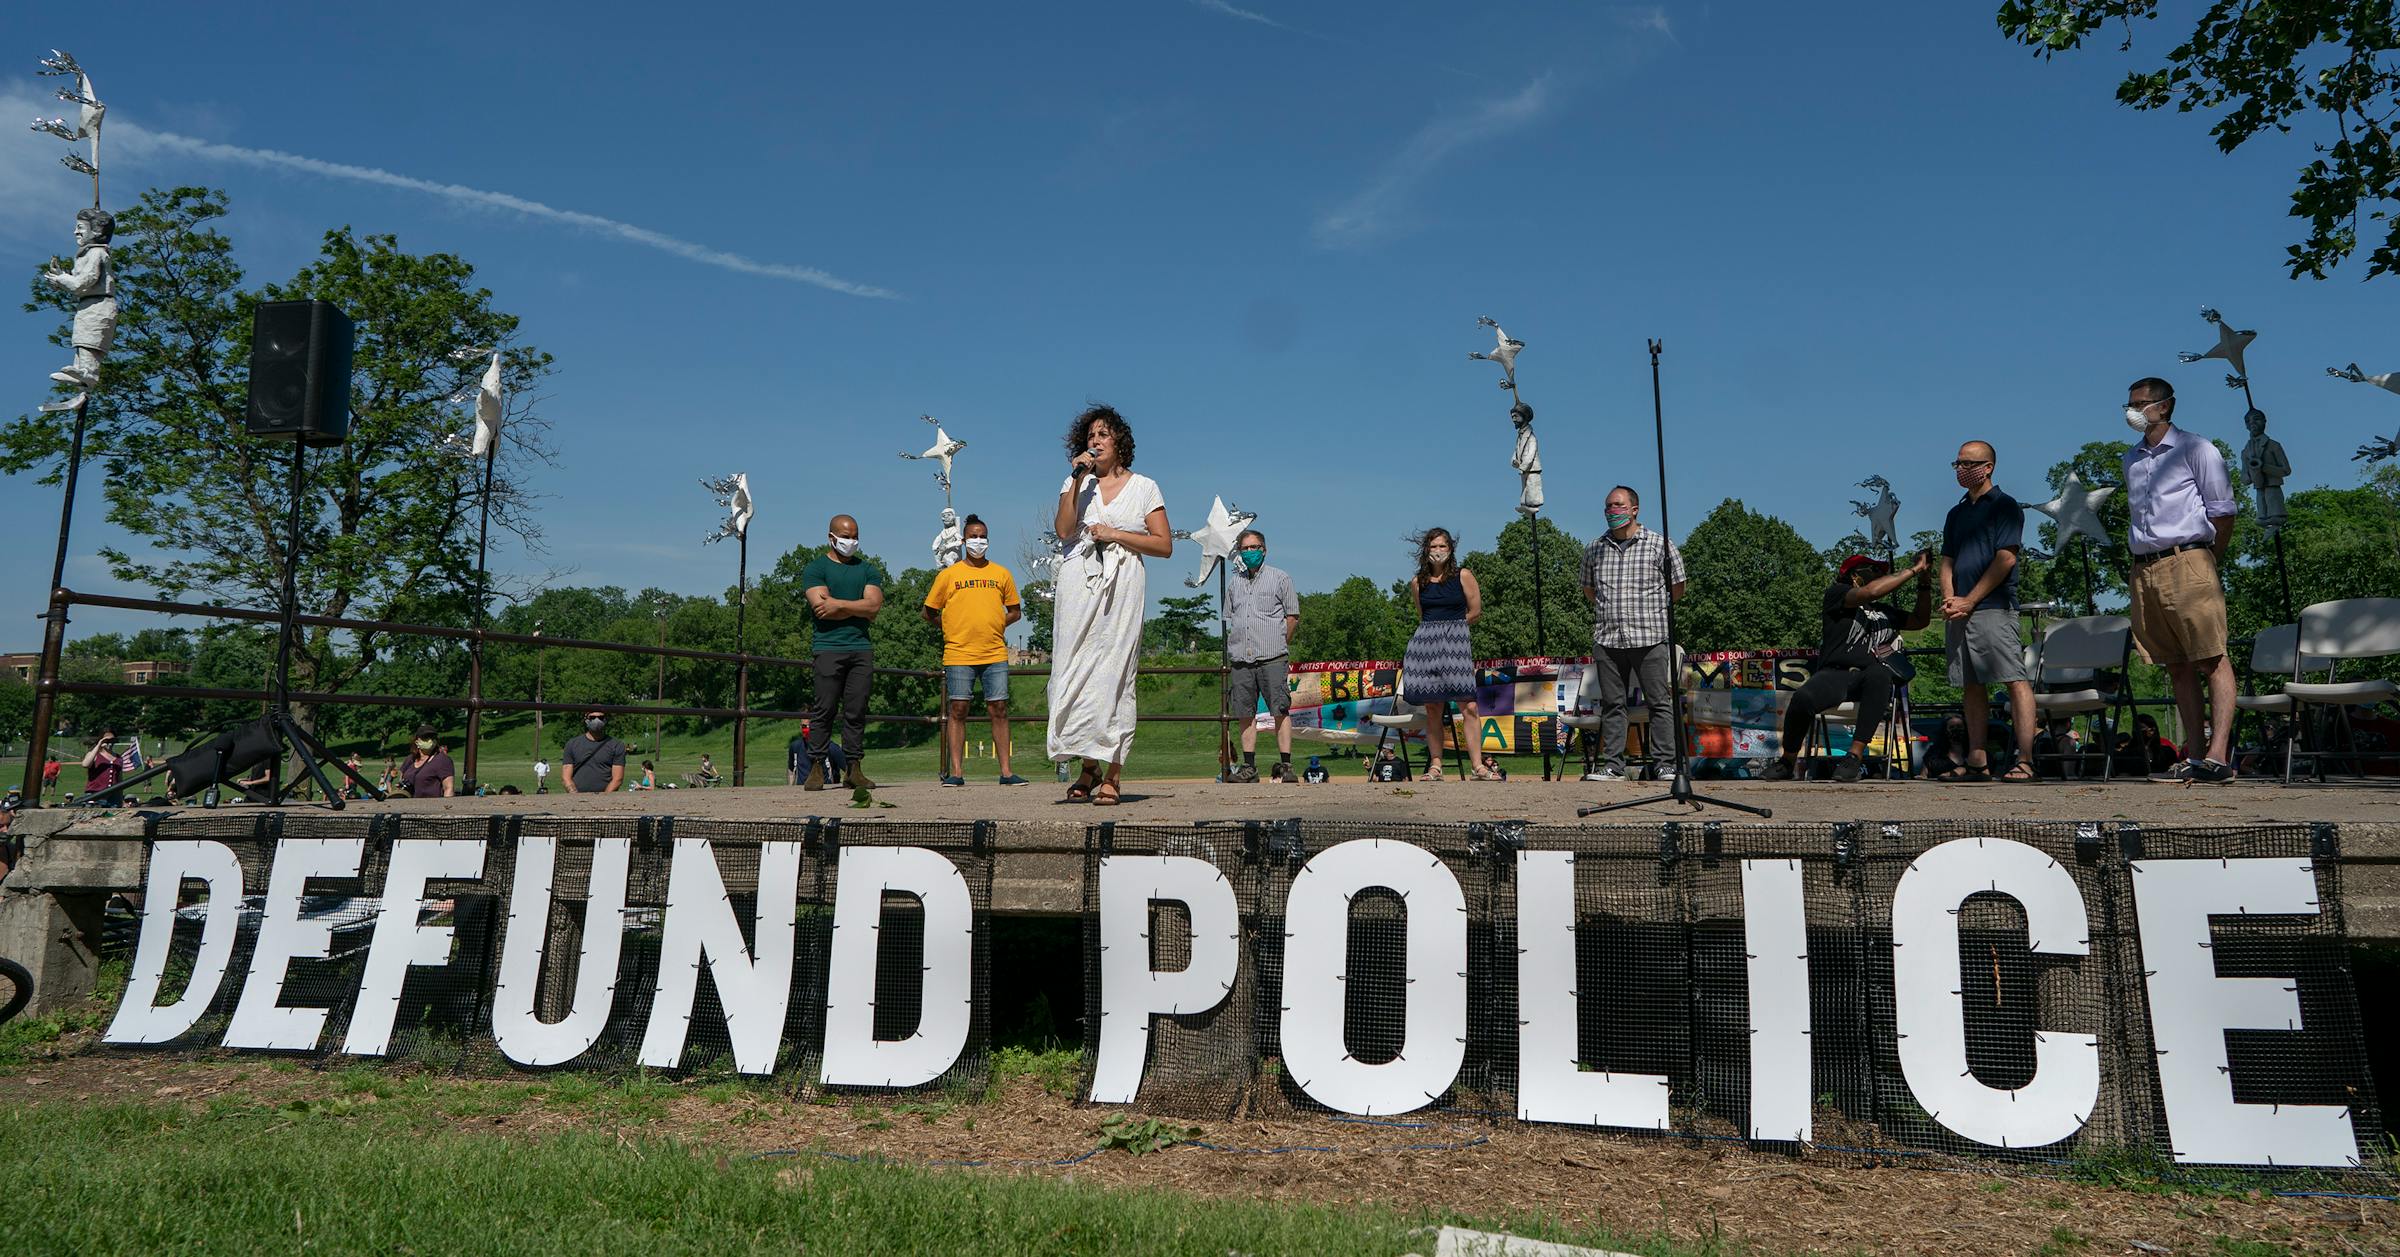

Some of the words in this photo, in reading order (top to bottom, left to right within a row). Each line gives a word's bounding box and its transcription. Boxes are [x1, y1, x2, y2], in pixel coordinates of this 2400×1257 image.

[1299, 662, 1326, 670] ARTIST
[1328, 661, 1369, 670] MOVEMENT
[1375, 660, 1402, 670] PEOPLE
[1491, 659, 1526, 668] LIBERATION
[1526, 657, 1566, 667] MOVEMENT
[1683, 653, 1712, 662] RATION
[1716, 651, 1726, 660] IS
[1728, 650, 1756, 660] BOUND
[1762, 650, 1773, 658] TO
[1776, 649, 1799, 657] YOUR
[102, 837, 972, 1088] DEFUND
[1089, 837, 2361, 1168] POLICE
